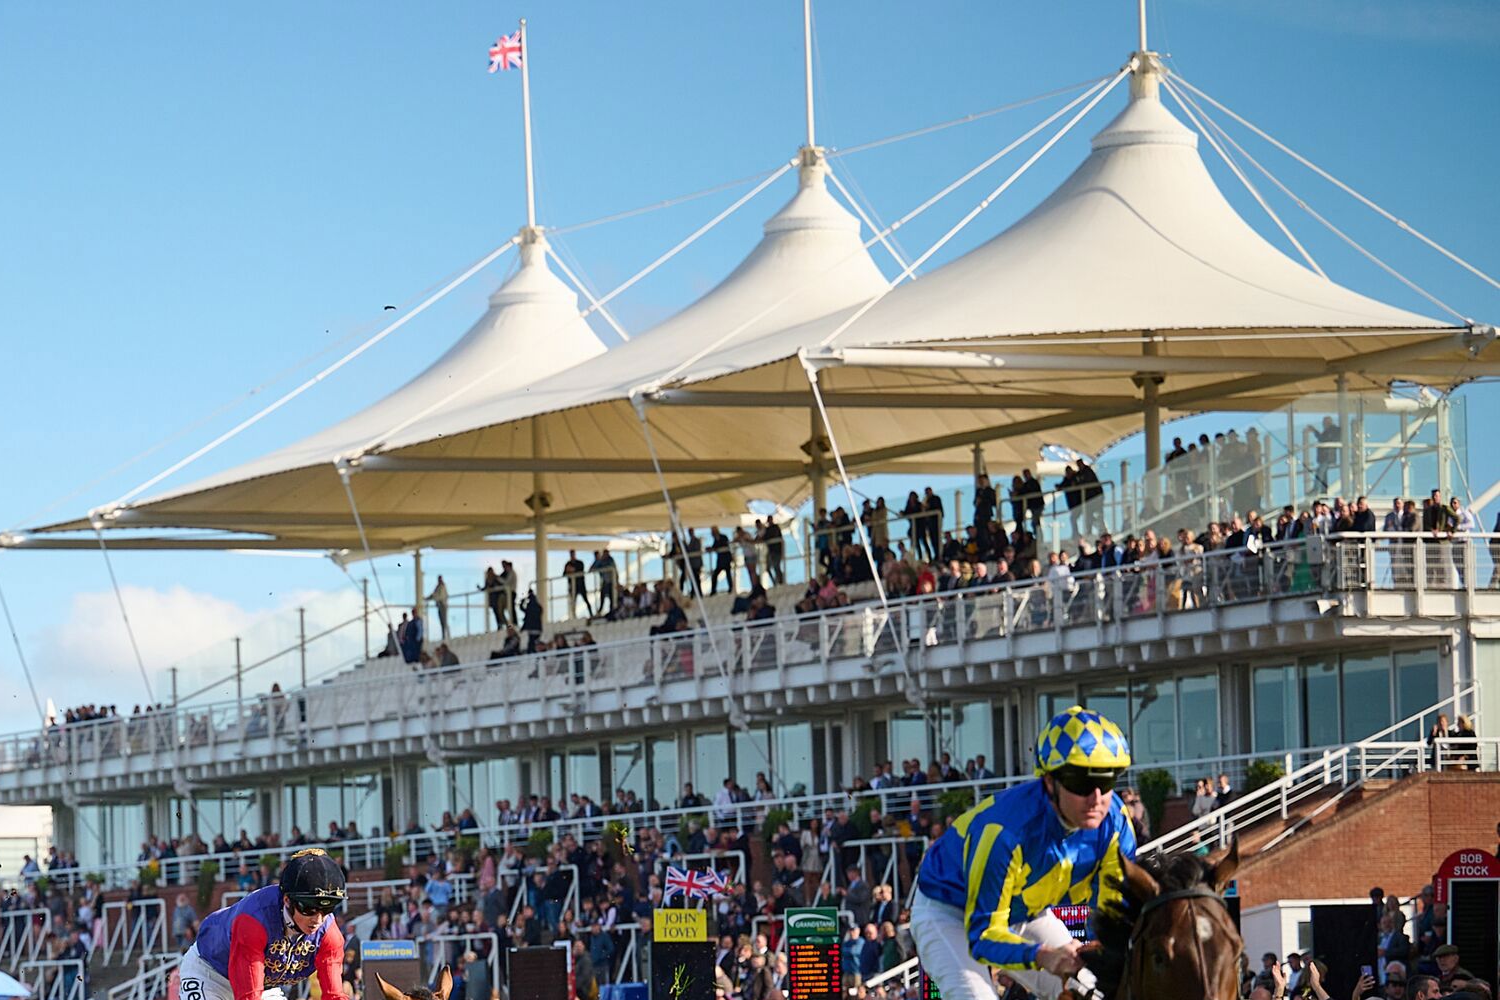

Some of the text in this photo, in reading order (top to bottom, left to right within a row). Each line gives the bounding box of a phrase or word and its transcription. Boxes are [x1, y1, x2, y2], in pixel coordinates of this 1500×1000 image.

[1460, 854, 1483, 864] BOB
[1453, 866, 1489, 876] STOCK
[665, 912, 697, 926] JOHN
[795, 920, 836, 929] GRANDSTAND
[661, 926, 699, 938] TOVEY
